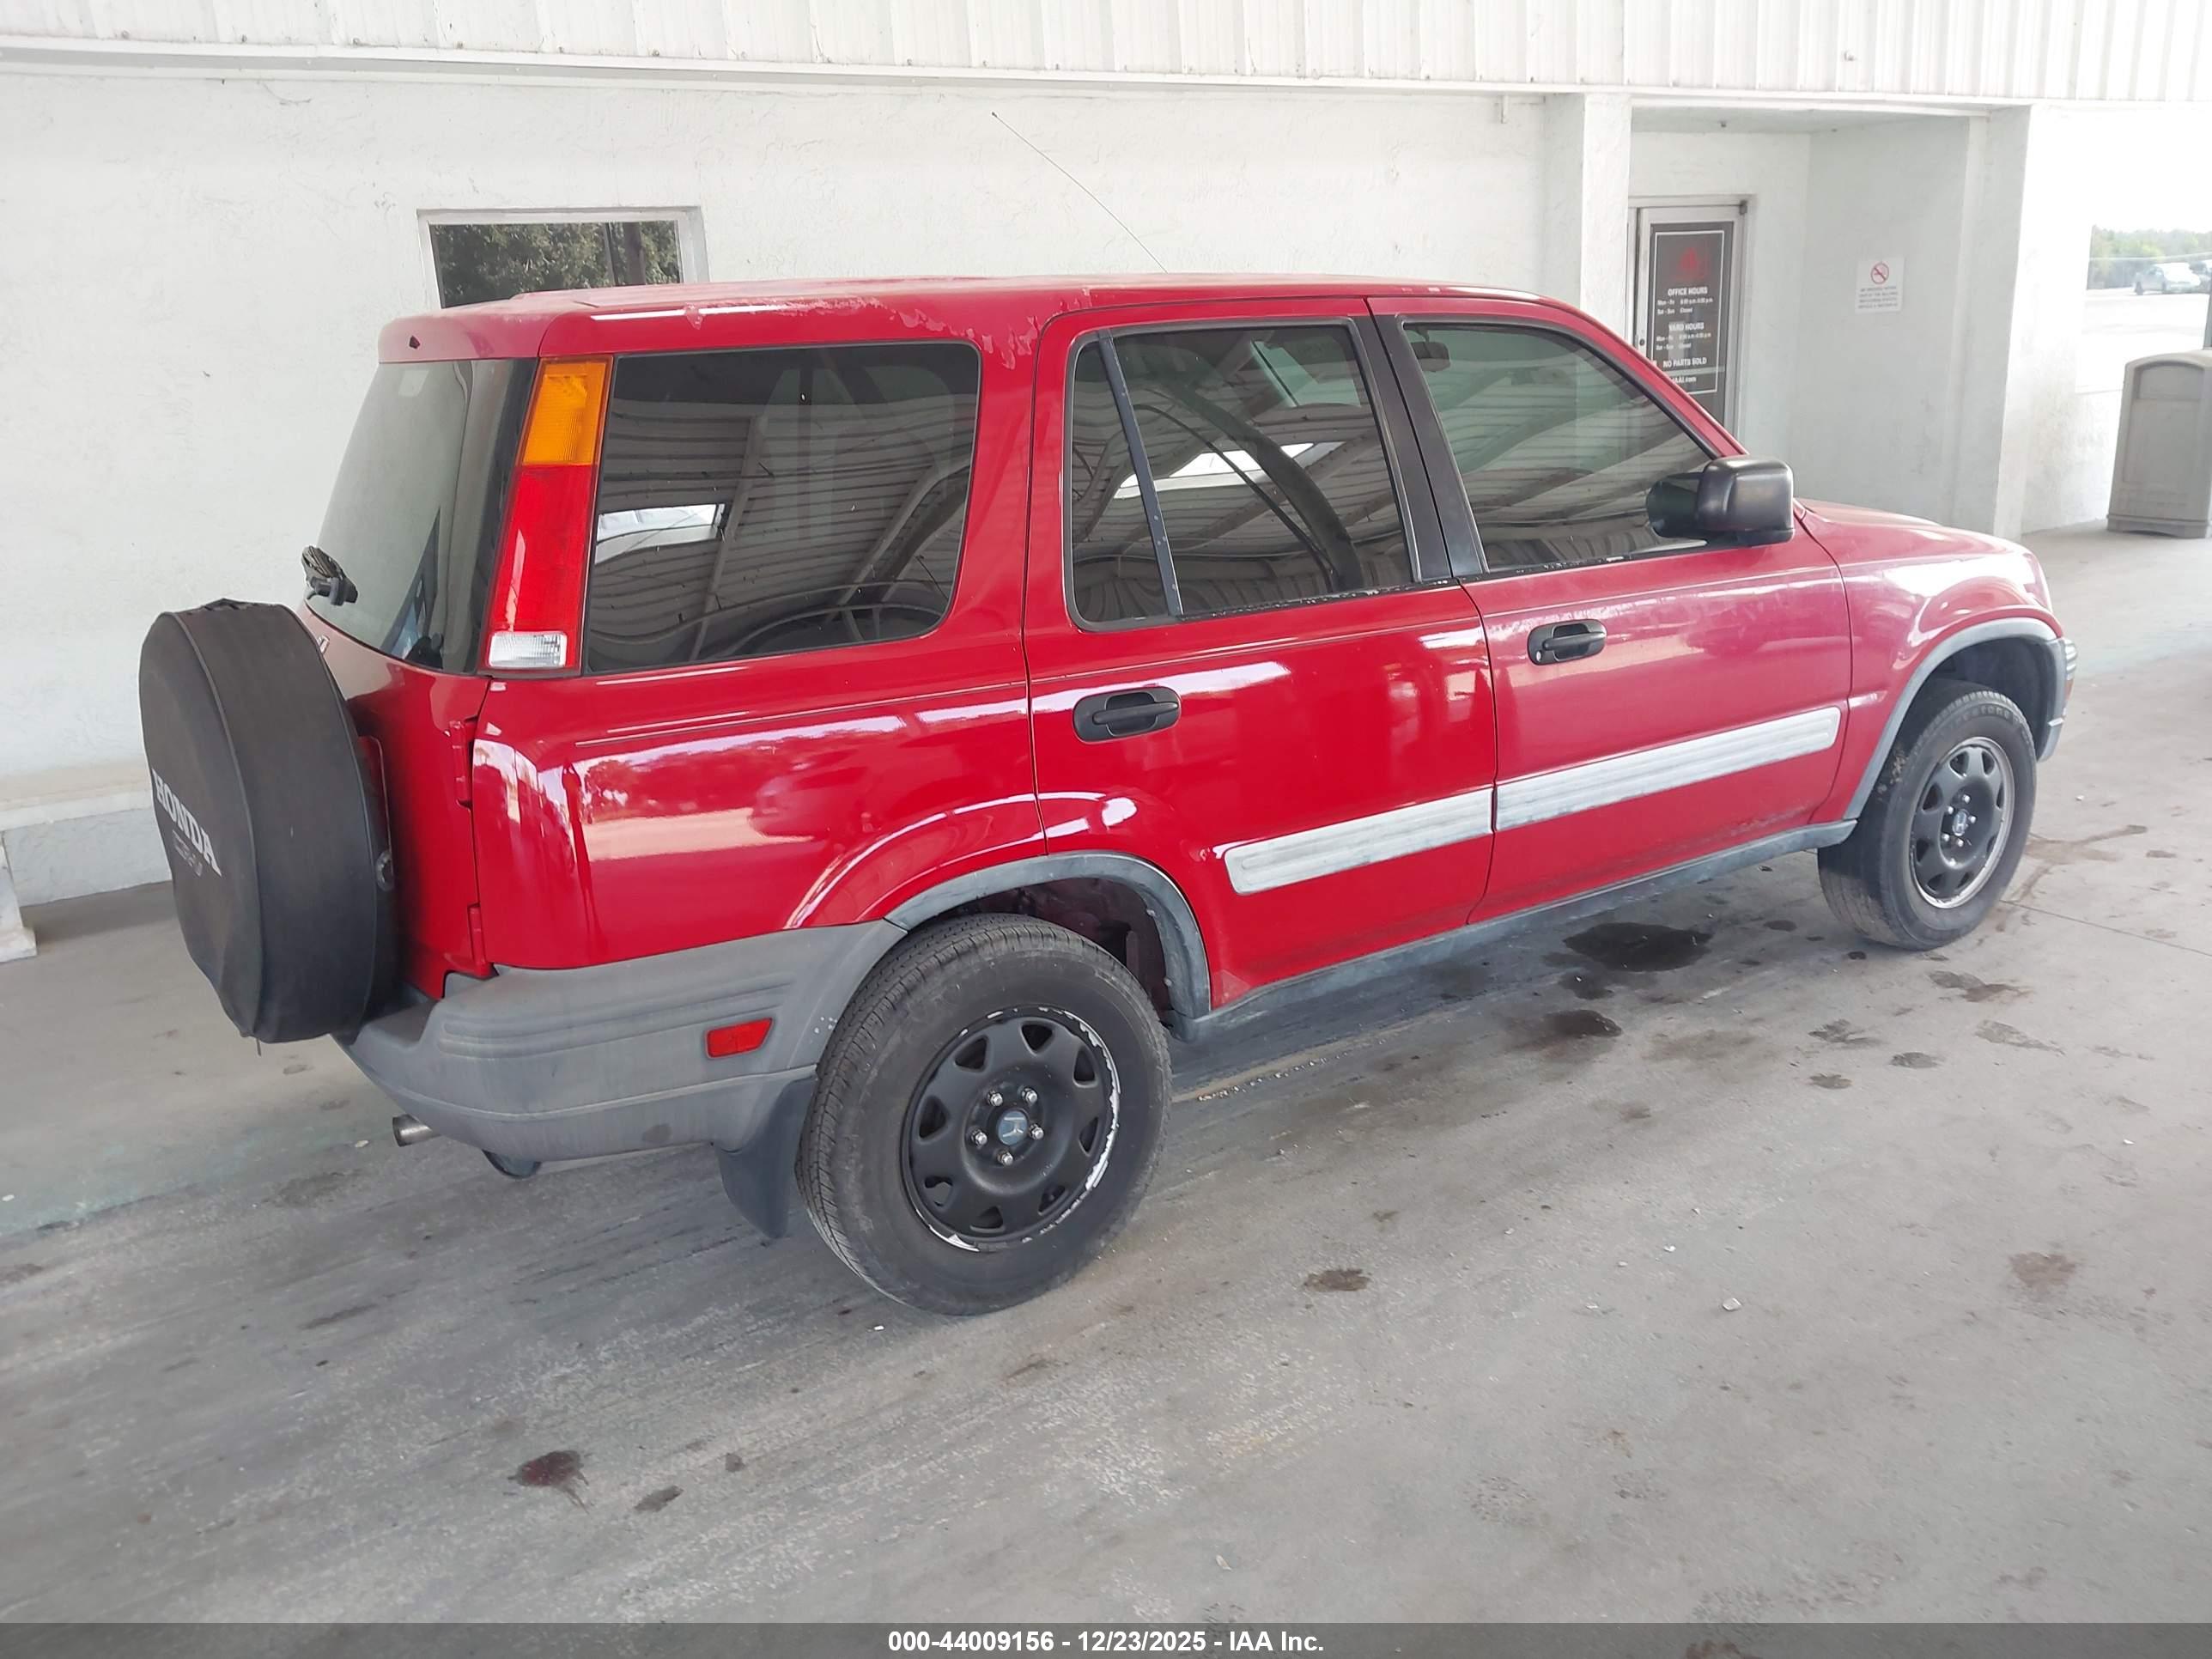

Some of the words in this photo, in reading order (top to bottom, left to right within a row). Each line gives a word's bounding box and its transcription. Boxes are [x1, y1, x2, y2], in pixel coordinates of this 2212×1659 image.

[1668, 287, 1687, 296] OFFICE
[1688, 286, 1708, 295] HOURS
[1668, 323, 1685, 331] YARD
[1685, 321, 1705, 331] HOURS
[1662, 360, 1672, 368] NO
[1673, 358, 1691, 367] PARTS
[1692, 356, 1707, 366] SOLD
[151, 767, 222, 877] HONDA
